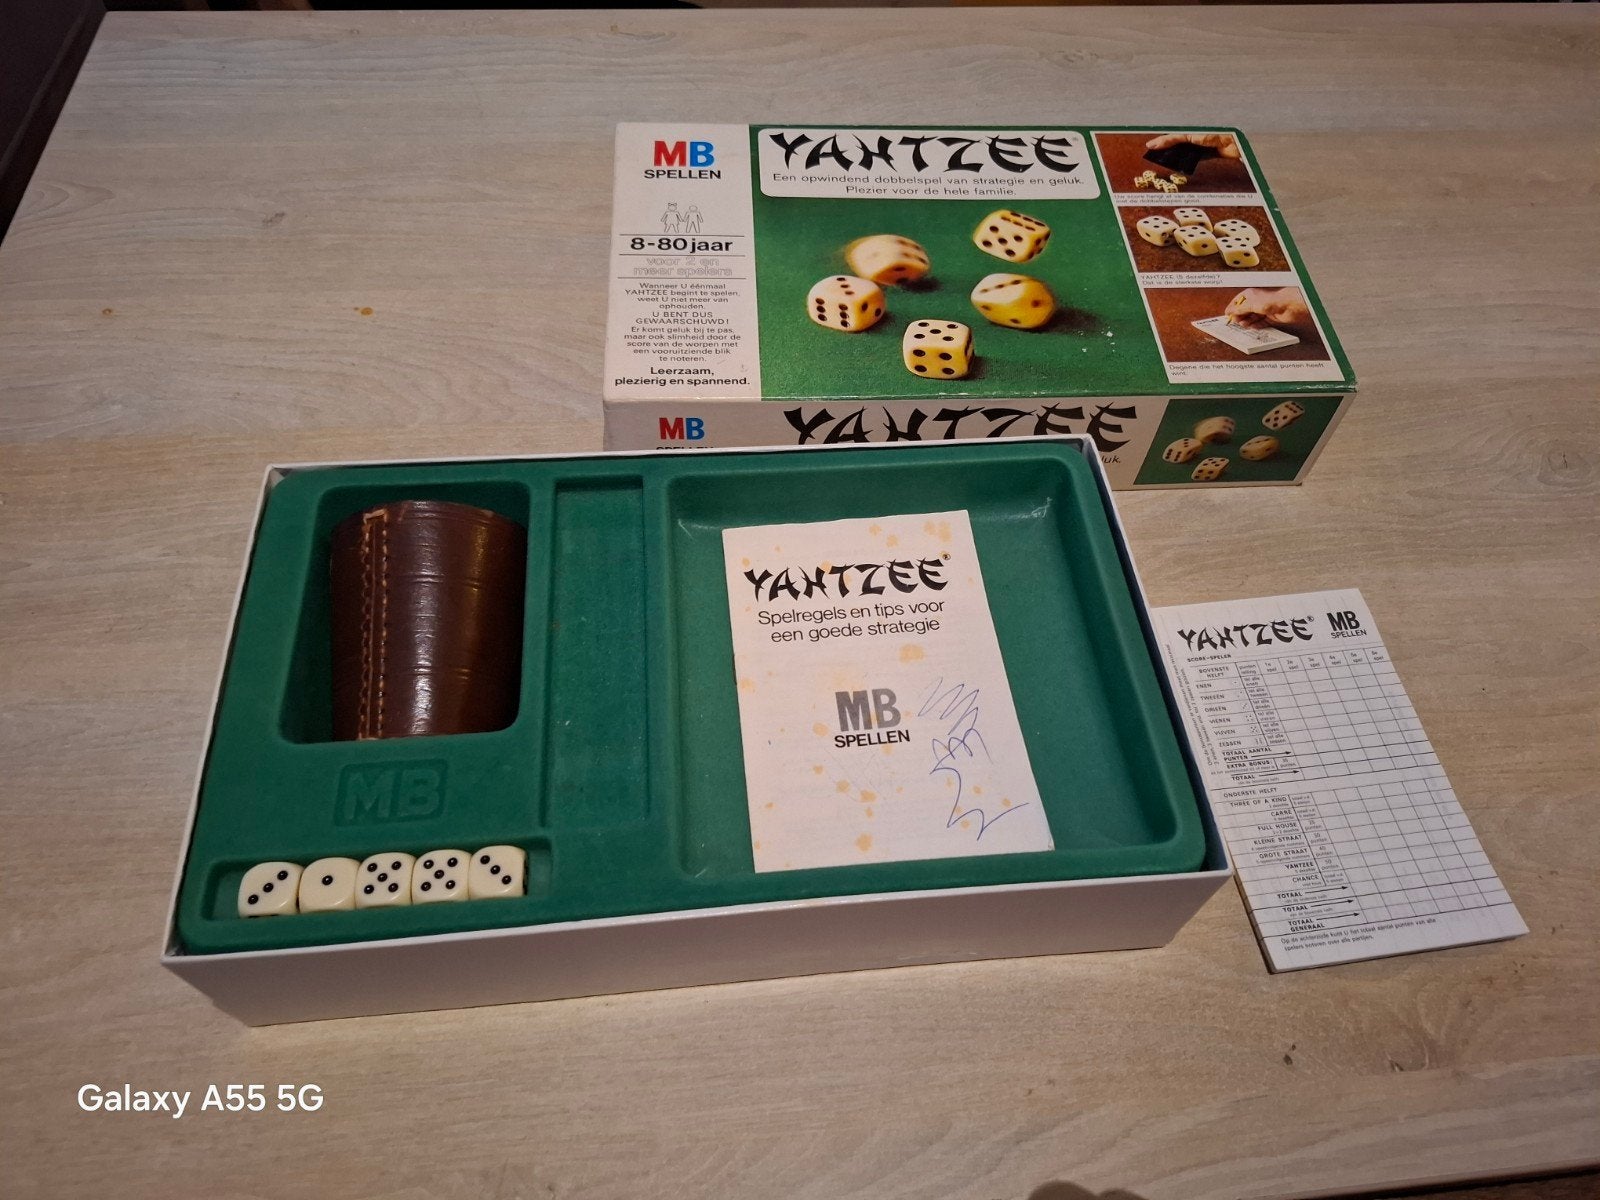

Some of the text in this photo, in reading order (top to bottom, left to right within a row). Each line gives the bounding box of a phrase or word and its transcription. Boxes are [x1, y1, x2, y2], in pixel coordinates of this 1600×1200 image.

[654, 140, 715, 167] MB
[644, 170, 721, 180] SPELLEN
[773, 173, 796, 182] Een
[802, 175, 870, 184] opwindend
[874, 175, 942, 185] dobbelspel
[972, 177, 1026, 186] strategie
[1049, 176, 1085, 186] geluk.
[846, 186, 887, 194] Plezier
[974, 188, 1017, 196] familie.
[630, 238, 733, 253] 8-80 jaar
[646, 256, 720, 266] voor 2 en
[633, 266, 732, 278] meer spelers
[650, 366, 715, 376] Leerzaam,
[615, 377, 666, 386] plezierig
[687, 377, 750, 386] spannend.
[659, 417, 705, 440] MB
[758, 600, 945, 627] Spelregels en tips voor
[1326, 610, 1360, 632] MB
[771, 618, 940, 642] een goede strategie
[1330, 629, 1368, 639] SPELLEN
[835, 688, 901, 732] MB
[834, 729, 910, 748] SPELLEN
[344, 768, 440, 819] MB
[1224, 790, 1256, 798] ONDERSTE
[1292, 874, 1319, 883] CHANCE
[1290, 923, 1325, 932] GENERAAL
